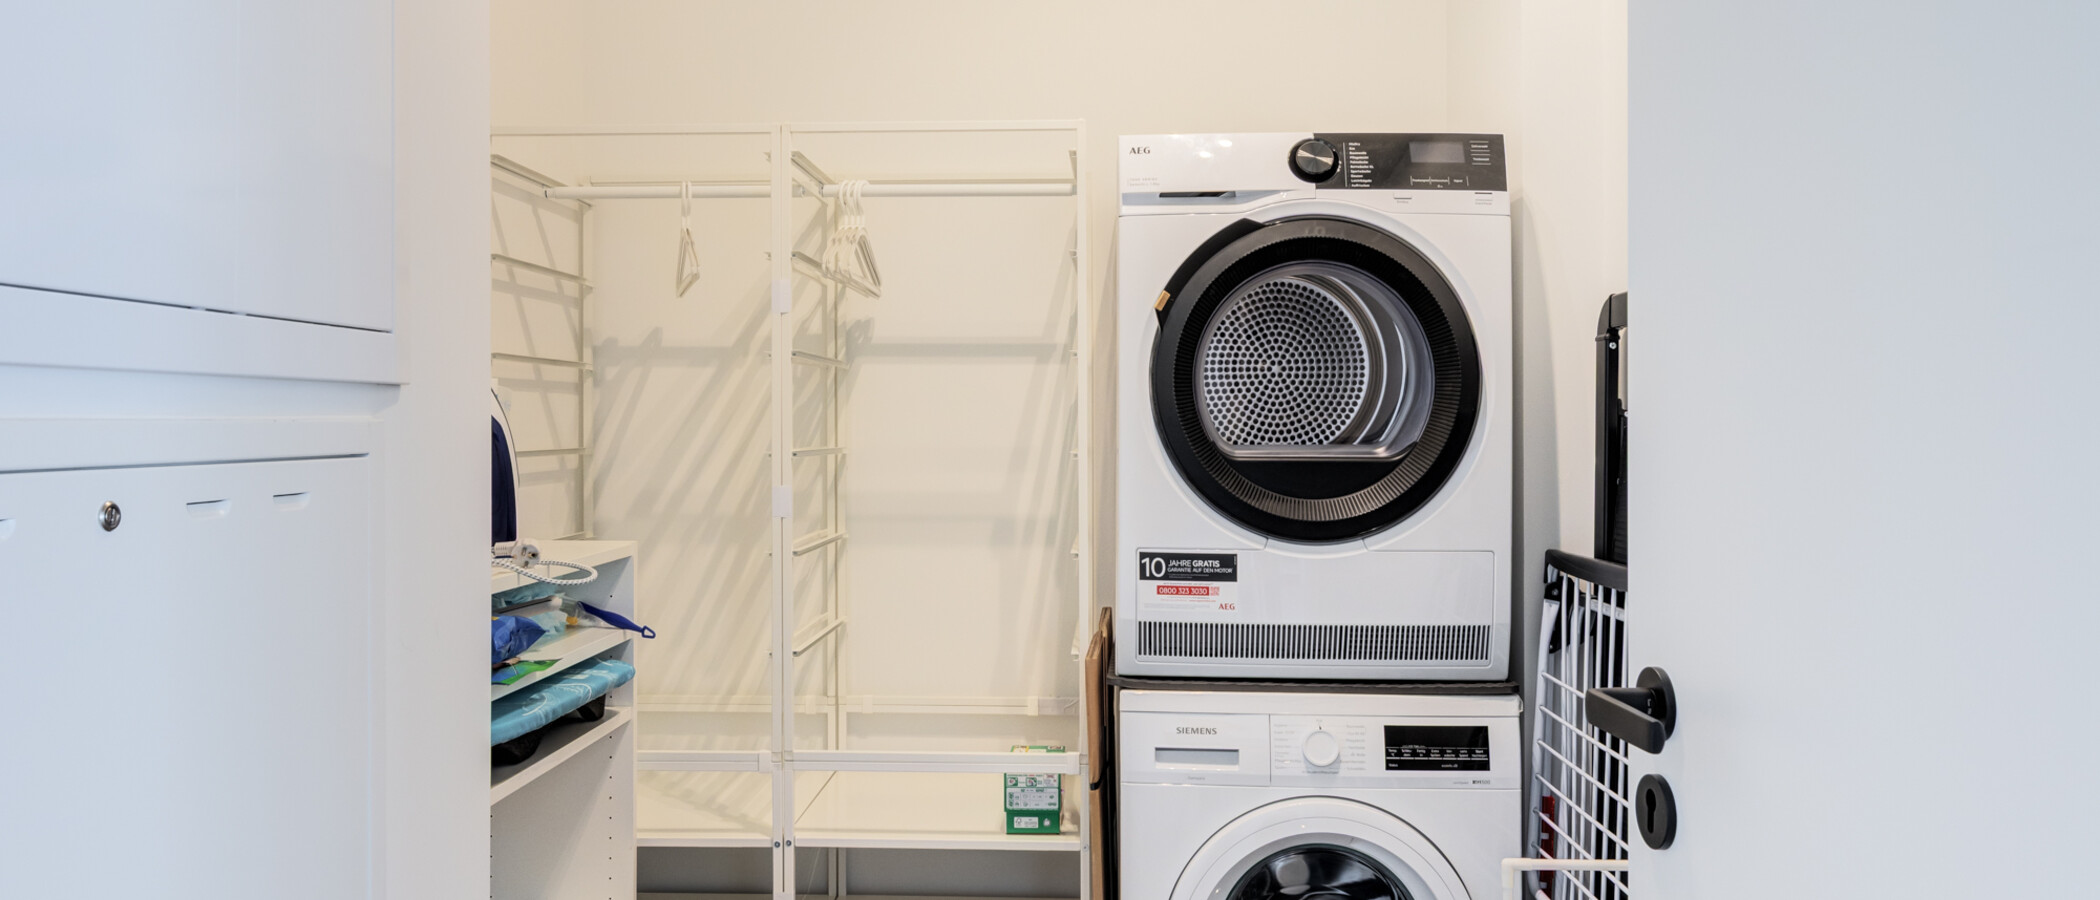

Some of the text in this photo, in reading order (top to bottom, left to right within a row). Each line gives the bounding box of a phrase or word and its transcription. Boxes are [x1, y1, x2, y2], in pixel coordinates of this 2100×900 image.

[1129, 146, 1151, 155] AEG
[1141, 557, 1166, 578] 10
[1159, 587, 1177, 595] 0800
[1176, 726, 1217, 735] SIEMENS
